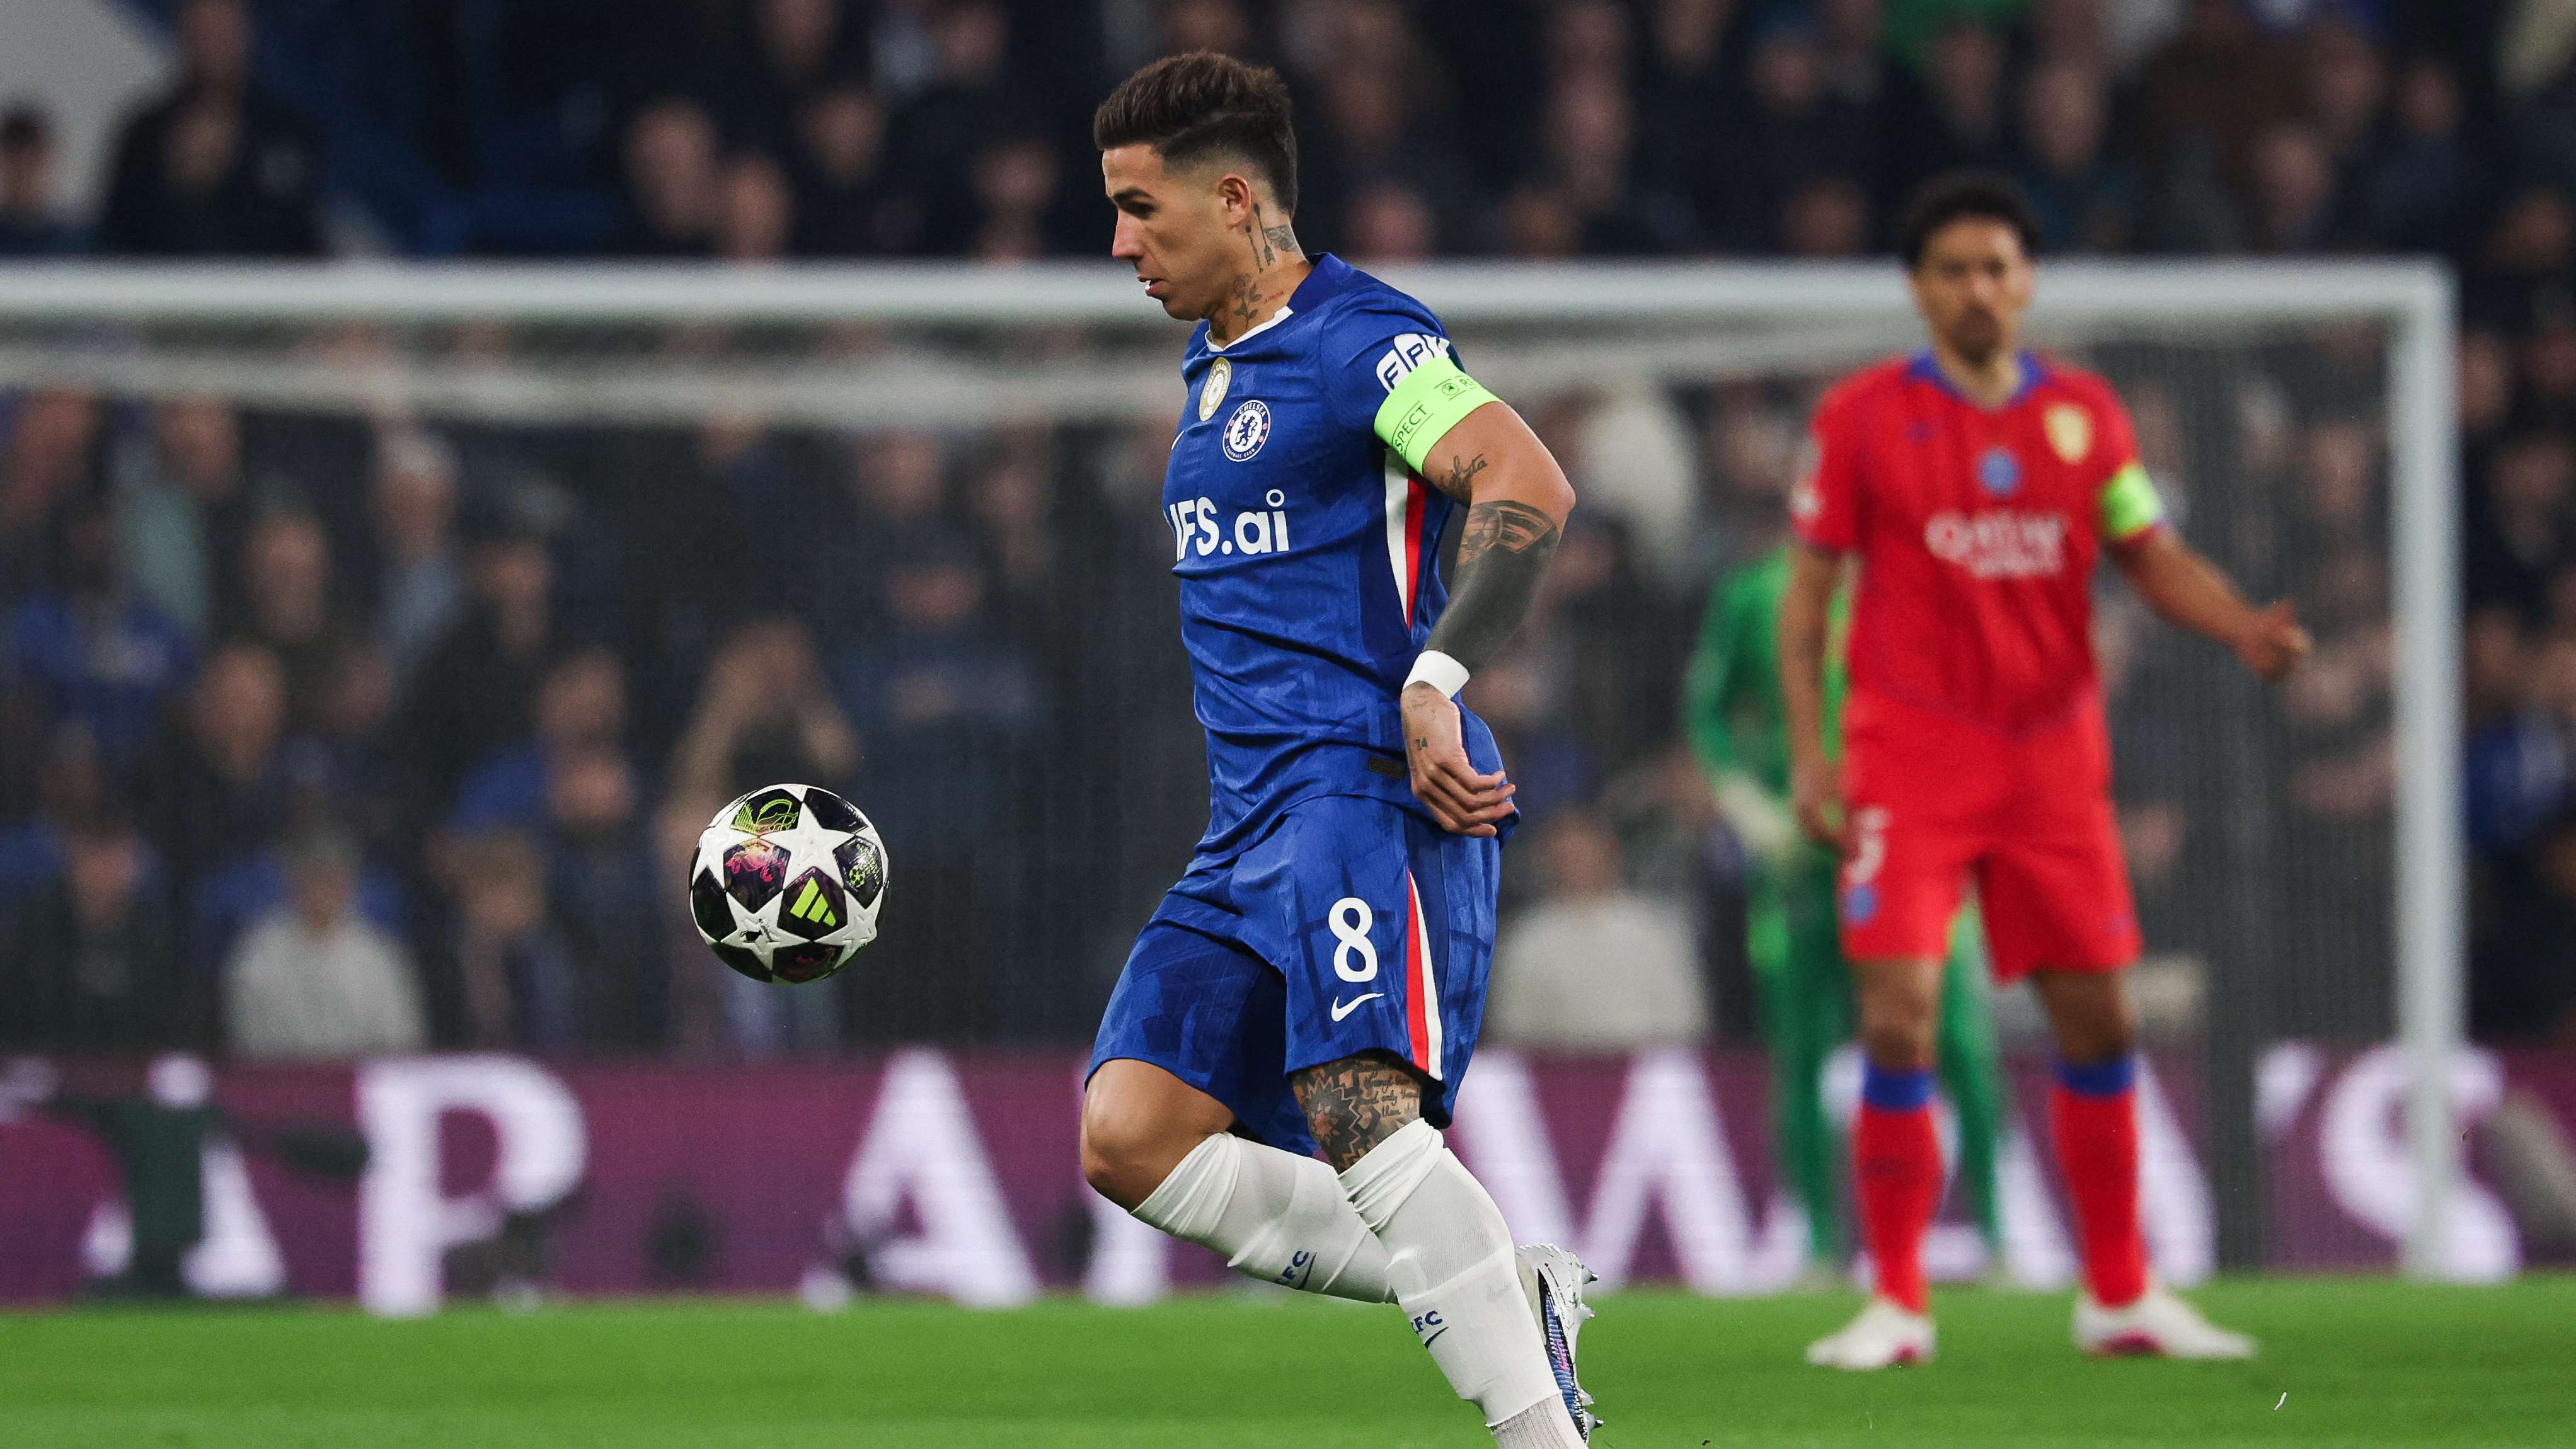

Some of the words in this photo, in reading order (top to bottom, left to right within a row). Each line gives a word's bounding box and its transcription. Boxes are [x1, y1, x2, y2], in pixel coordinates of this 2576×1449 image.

[1381, 334, 1448, 391] FP
[1239, 403, 1266, 417] CHELSEA
[1394, 404, 1427, 457] SPECT
[1169, 489, 1289, 562] IFS.ai
[1328, 897, 1378, 983] 8
